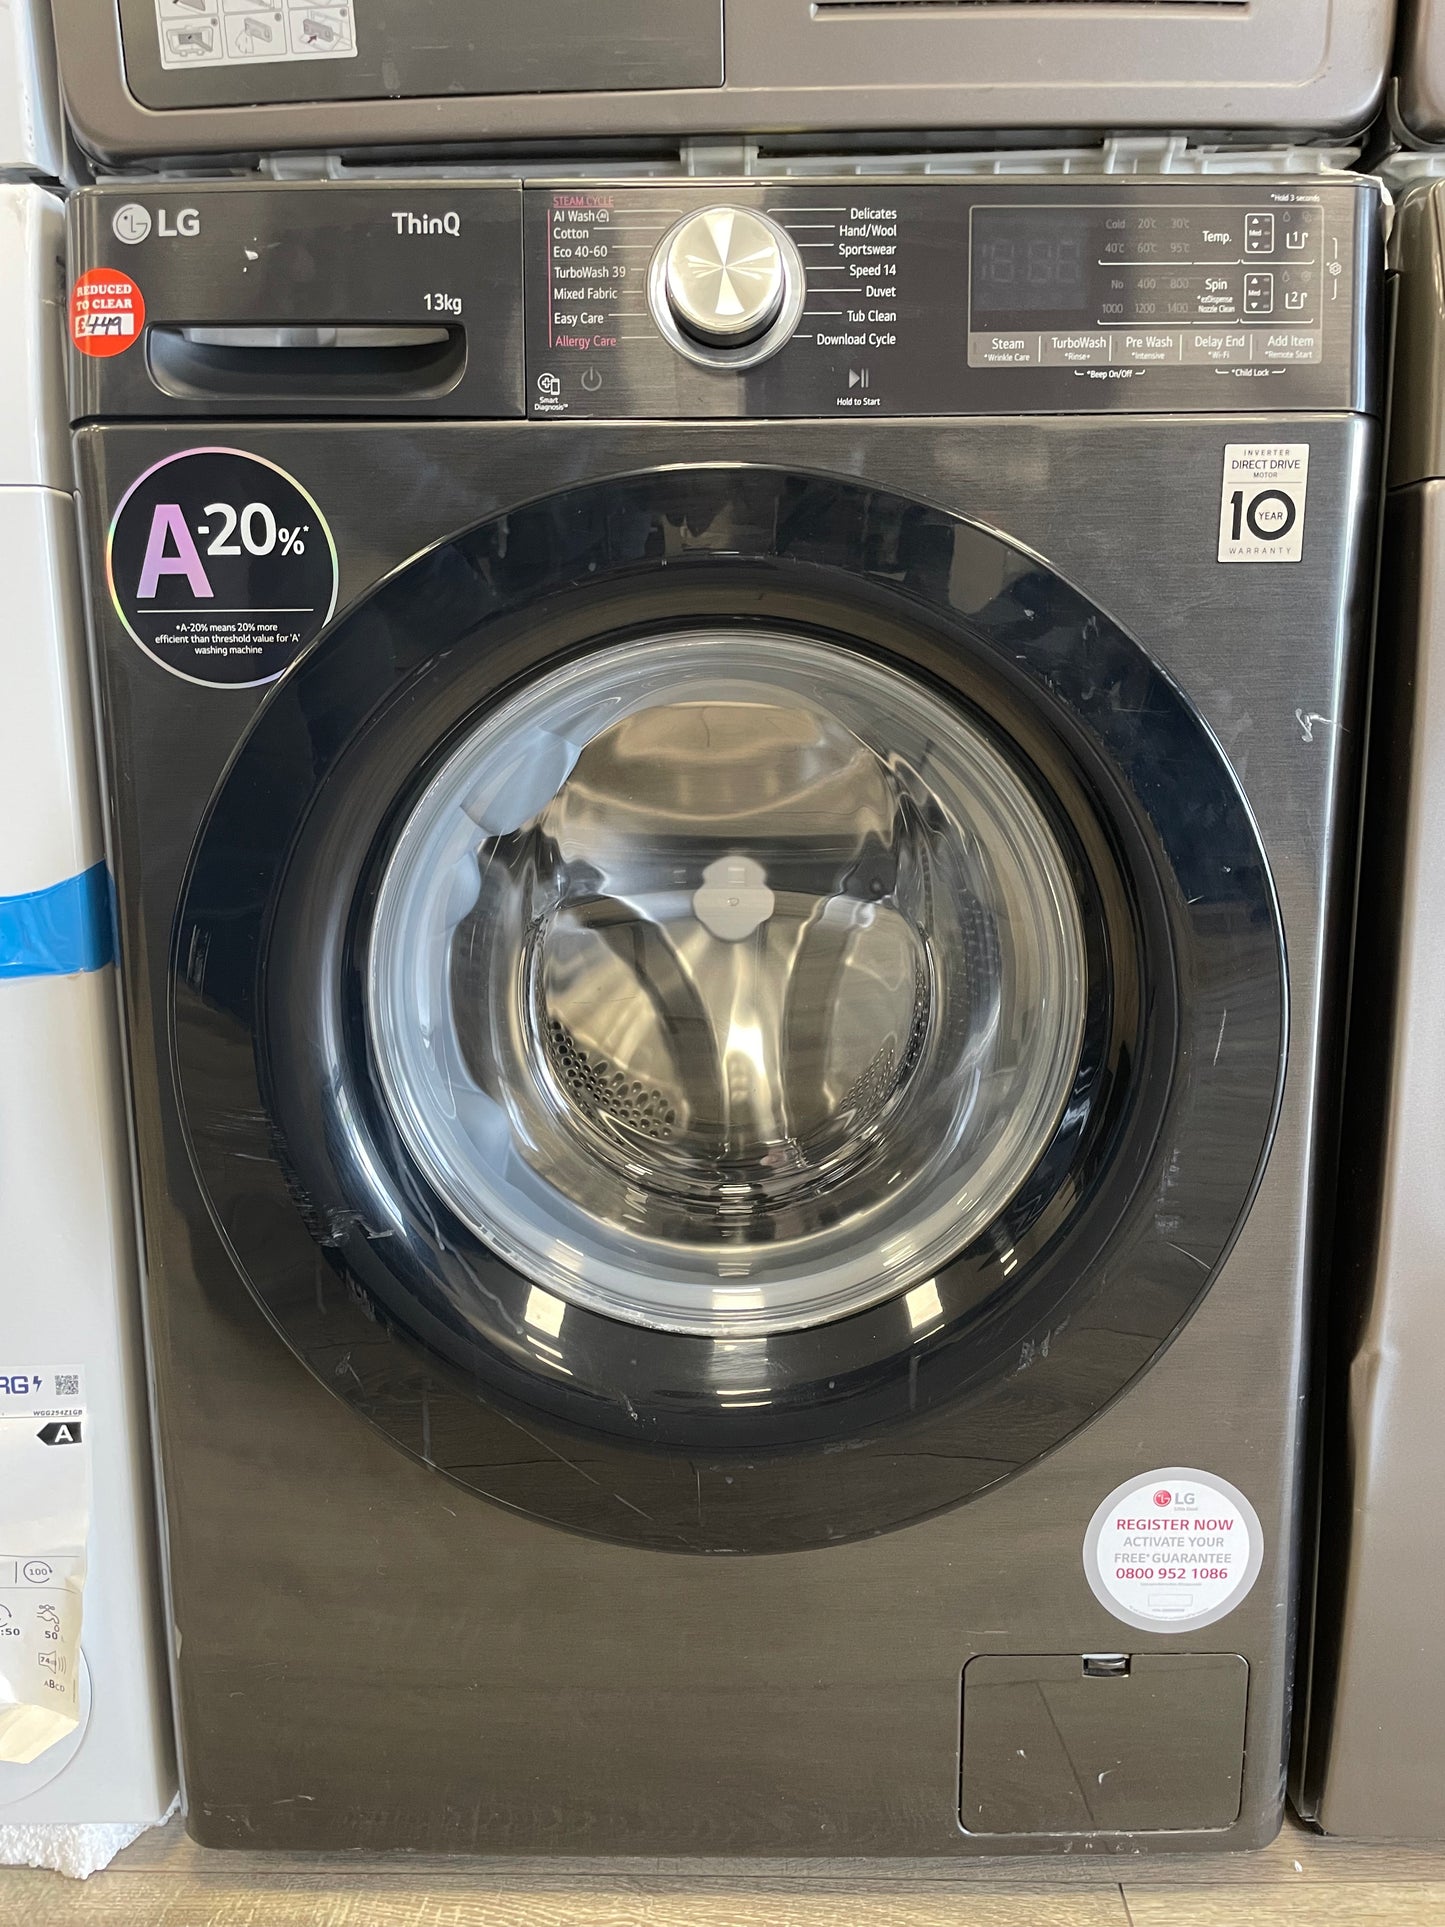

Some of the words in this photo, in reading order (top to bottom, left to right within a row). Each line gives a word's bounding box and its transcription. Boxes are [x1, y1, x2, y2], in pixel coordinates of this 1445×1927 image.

[553, 196, 583, 206] STEAM
[586, 196, 614, 205] CYCLE
[553, 210, 564, 222] AI
[568, 210, 595, 222] Wash
[851, 207, 897, 219] Delicates
[158, 208, 200, 237] LG
[392, 212, 460, 236] ThinQ
[1105, 219, 1125, 229] Cold
[553, 227, 589, 239] Cotton
[840, 224, 897, 237] Hand/Wool
[1202, 230, 1232, 245] Temp.
[553, 246, 572, 258] Eco
[575, 245, 607, 257] 40-60
[838, 243, 896, 258] Sportswear
[554, 267, 609, 278] TurboWash
[612, 266, 626, 278] 39
[850, 264, 881, 278] Speed
[883, 264, 896, 276] 14
[1111, 280, 1124, 289] No
[1137, 279, 1156, 289] 400
[1170, 278, 1189, 288] 800
[1205, 278, 1227, 292] Spin
[77, 284, 132, 297] REDUCED
[554, 288, 584, 300] Mixed
[587, 287, 618, 299] Fabric
[866, 285, 896, 297] Duvet
[76, 300, 90, 311] TO
[92, 298, 132, 309] CLEAR
[424, 293, 462, 315] 13kg
[1102, 303, 1123, 314] 1000
[1135, 303, 1155, 313] 1200
[1168, 303, 1188, 313] 1400
[554, 313, 578, 327] Easy
[580, 312, 604, 324] Care
[847, 310, 865, 322] Tub
[868, 310, 897, 322] Clean
[556, 335, 590, 349] Allergy
[593, 335, 616, 346] Care
[817, 333, 866, 345] Download
[869, 333, 896, 348] Cycle
[992, 338, 1024, 350] Steam
[1052, 337, 1106, 348] TurboWash
[1126, 336, 1143, 348] Pre
[1146, 336, 1173, 348] Wash
[1195, 336, 1225, 350] Delay
[1226, 335, 1245, 347] End
[1267, 336, 1288, 346] Add
[1290, 336, 1314, 346] Item
[1014, 353, 1030, 361] Care
[1295, 350, 1312, 358] Start
[1108, 370, 1133, 379] On/Off
[1253, 368, 1270, 376] Lock
[539, 396, 558, 404] Smart
[836, 398, 852, 406] Hold
[854, 398, 862, 406] to
[863, 398, 880, 406] Start
[1232, 460, 1267, 470] DIRECT
[1270, 460, 1300, 469] DRIVE
[1230, 489, 1296, 541] 10
[1259, 512, 1283, 520] YEAR
[209, 624, 236, 632] means
[237, 623, 256, 632] 20%
[155, 634, 189, 643] efficient
[190, 634, 210, 643] than
[212, 634, 251, 643] threshold
[252, 634, 275, 642] value
[276, 634, 288, 642] for
[195, 645, 228, 656] washing
[229, 646, 263, 654] machine
[54, 1425, 74, 1443] A
[1175, 1493, 1195, 1505] LG
[1117, 1519, 1189, 1531] REGISTER
[1194, 1519, 1234, 1531] NOW
[1123, 1537, 1185, 1547] ACTIVATE
[1188, 1537, 1224, 1547] YOUR
[1152, 1553, 1232, 1563] GUARANTEE
[29, 1568, 47, 1576] 100
[1116, 1568, 1154, 1579] 0800
[1158, 1568, 1186, 1579] 952
[1192, 1568, 1228, 1579] 1086
[45, 1630, 58, 1640] 50
